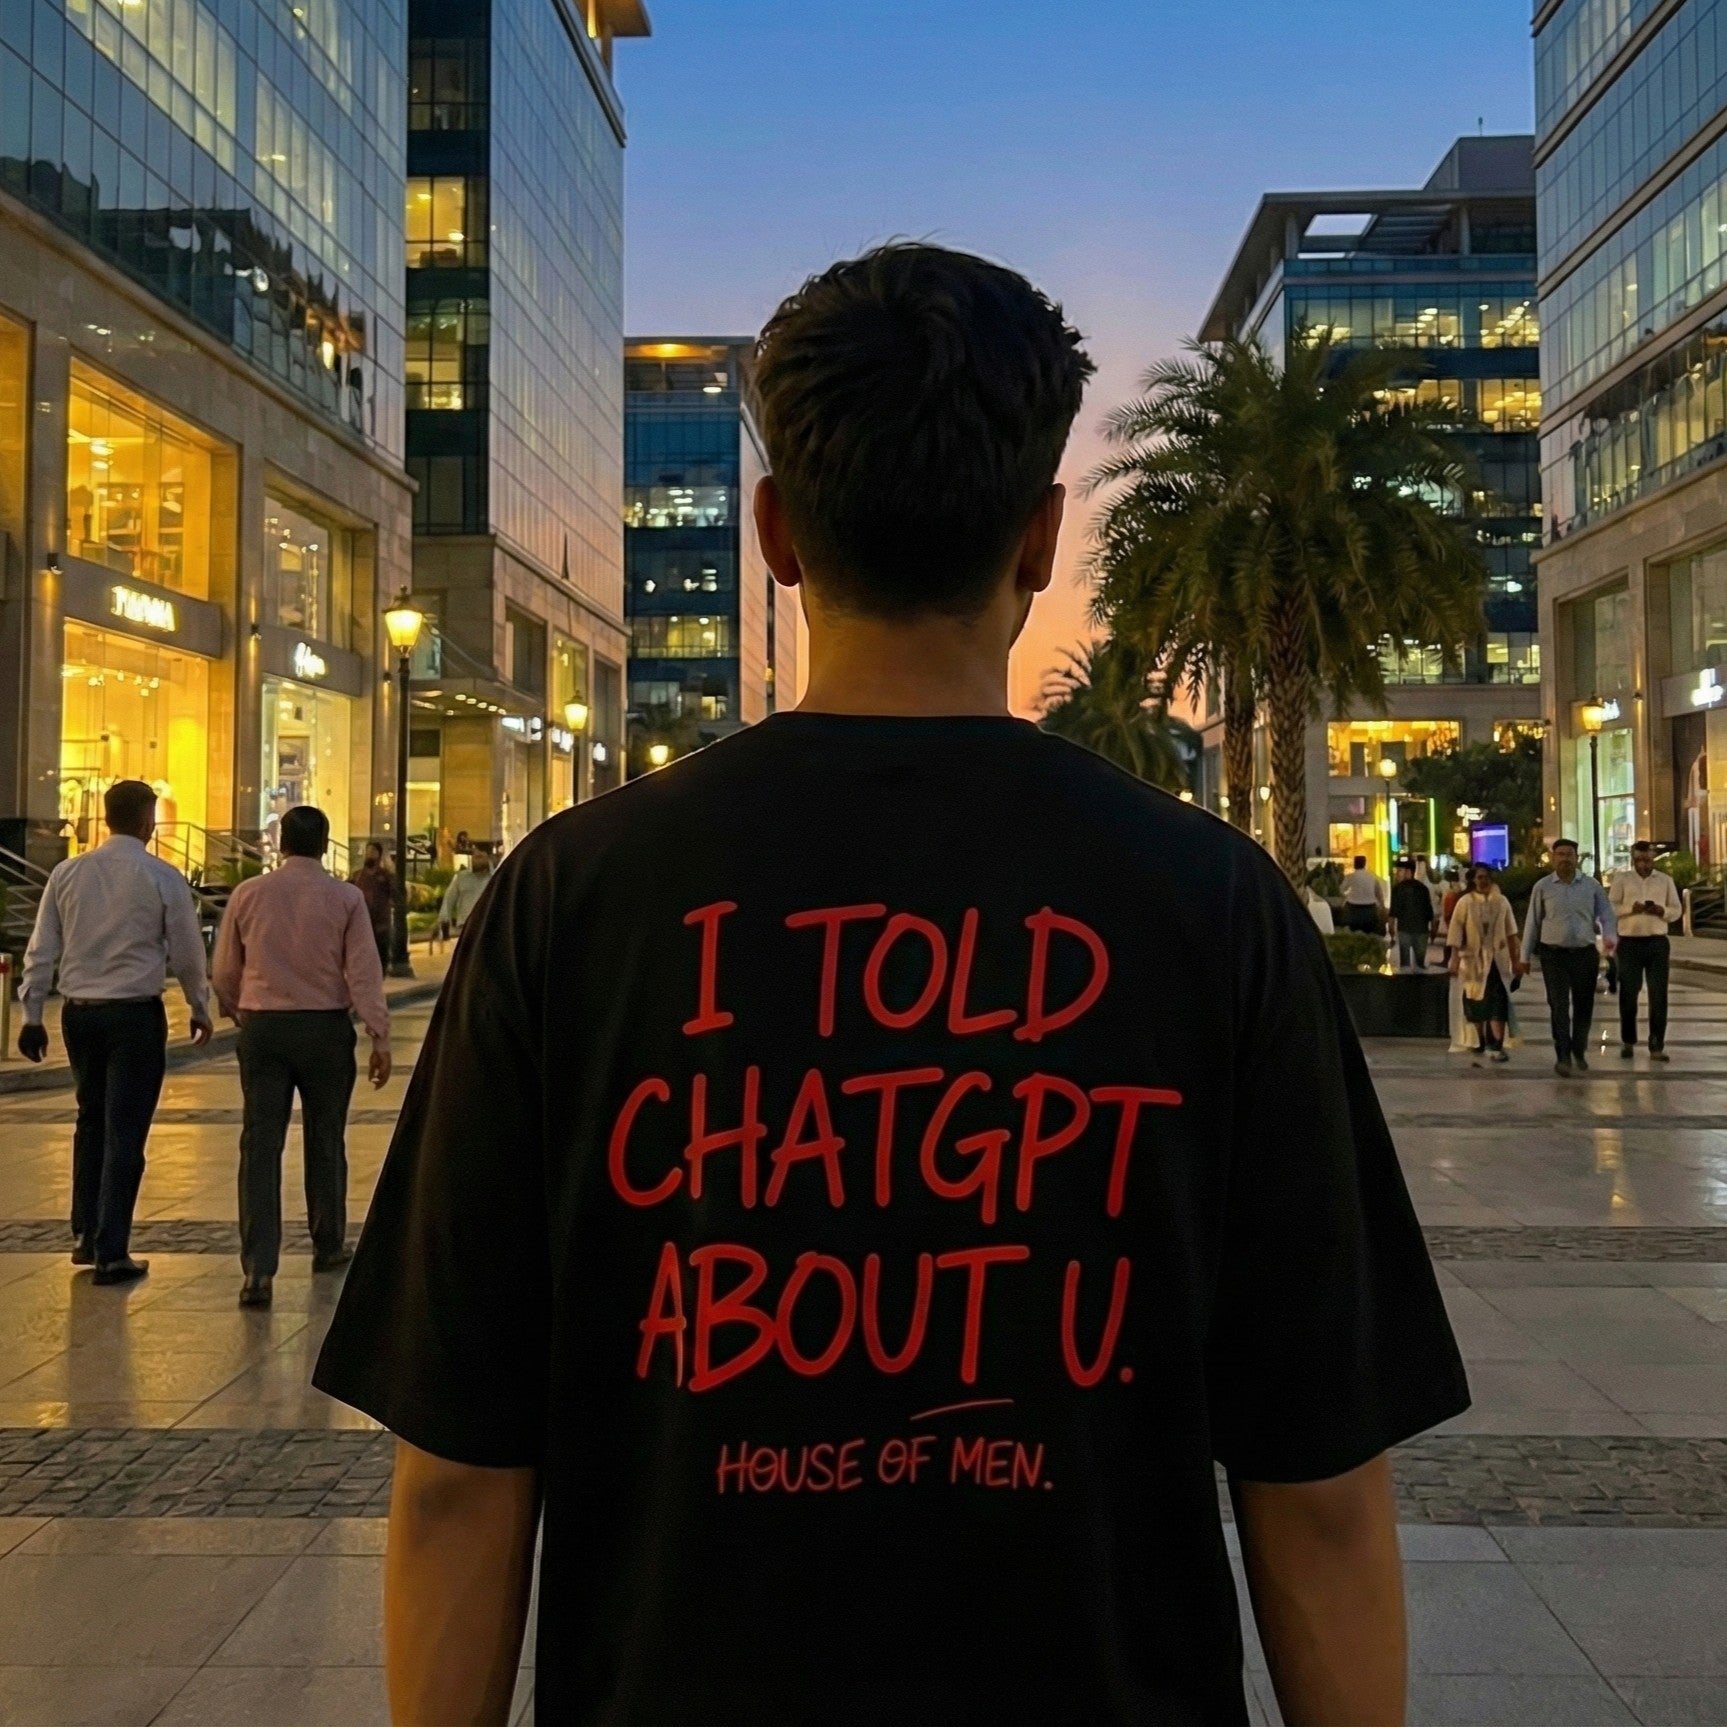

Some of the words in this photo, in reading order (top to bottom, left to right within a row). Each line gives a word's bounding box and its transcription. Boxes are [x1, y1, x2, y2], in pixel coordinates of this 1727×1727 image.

[683, 901, 736, 1036] I
[786, 903, 1110, 1041] TOLD
[608, 1066, 1182, 1225] CHATGPT
[637, 1241, 1030, 1392] ABOUT
[1061, 1258, 1134, 1388] U.
[716, 1440, 864, 1494] HOUSE
[878, 1436, 937, 1484] OF
[950, 1436, 1054, 1491] MEN.
